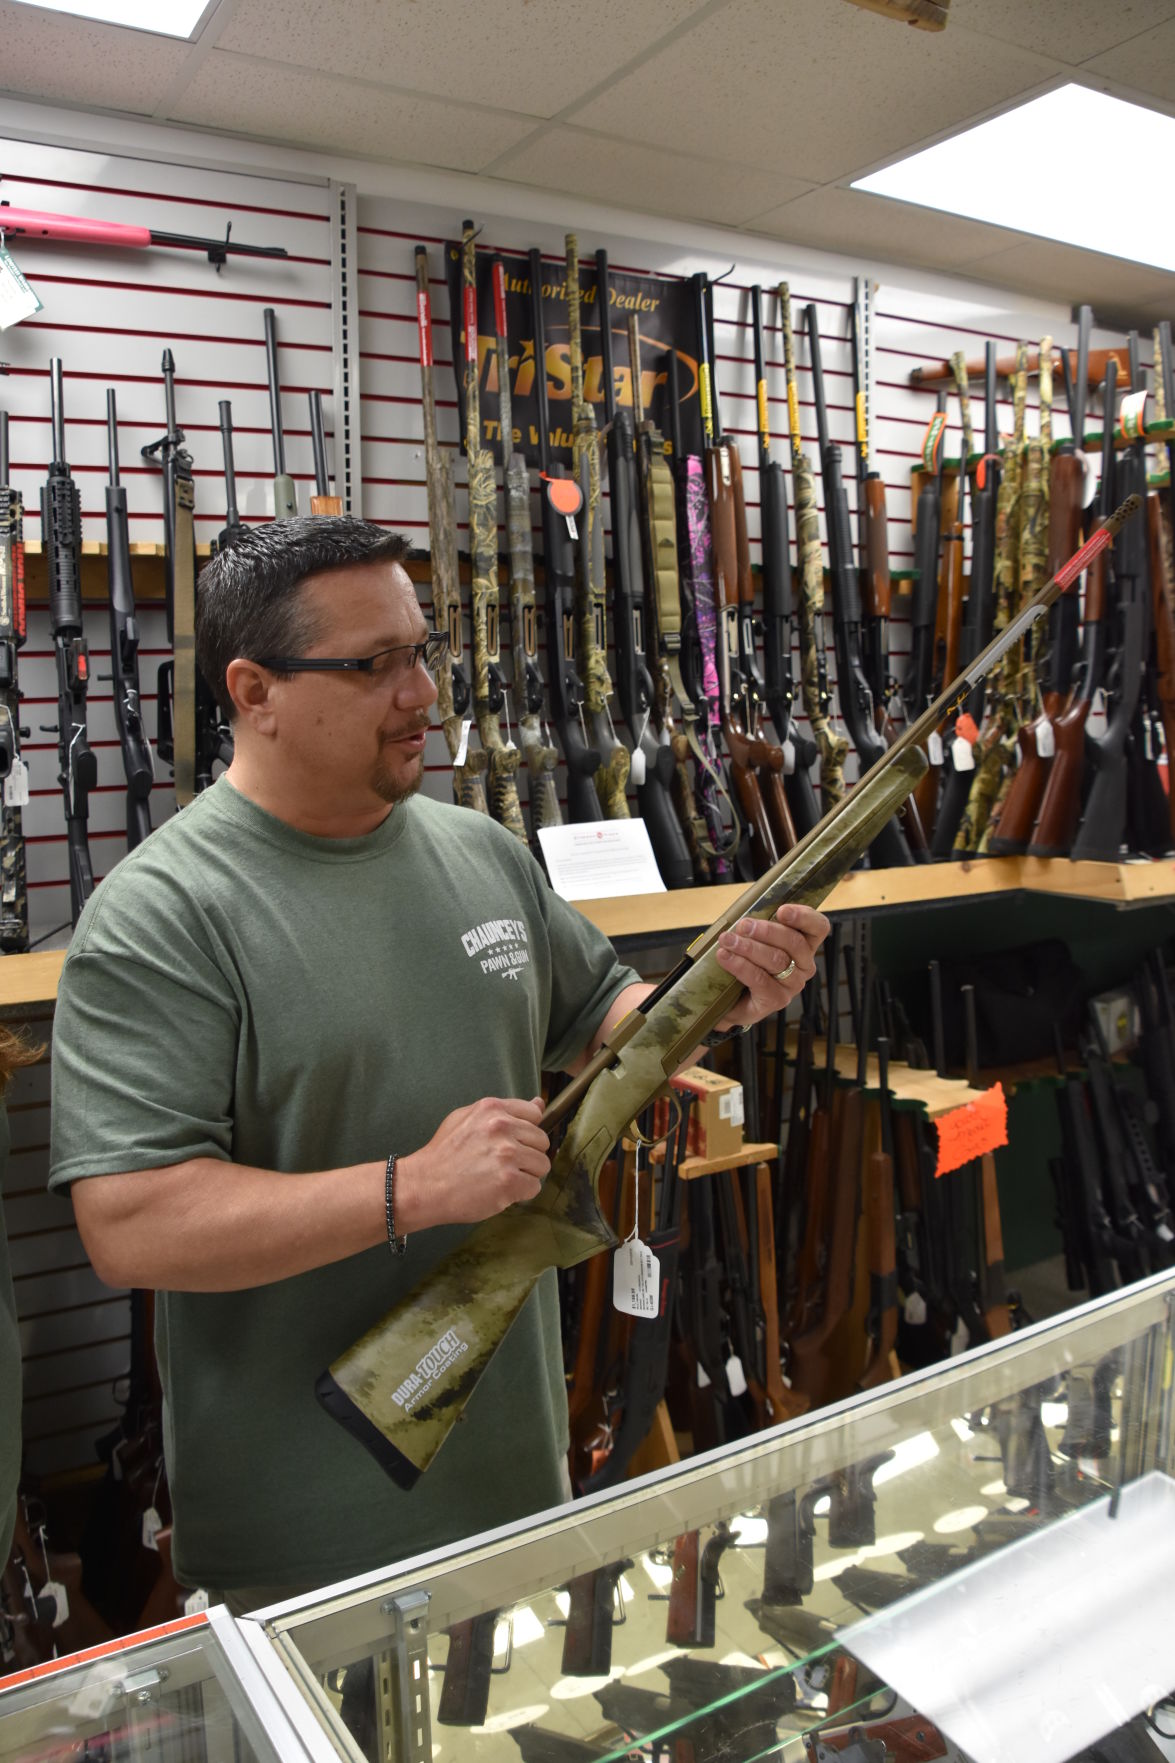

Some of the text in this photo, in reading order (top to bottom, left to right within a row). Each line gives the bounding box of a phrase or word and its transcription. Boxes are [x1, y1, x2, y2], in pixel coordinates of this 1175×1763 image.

[480, 954, 511, 974] PAWN
[404, 1342, 469, 1413] Armor Coating
